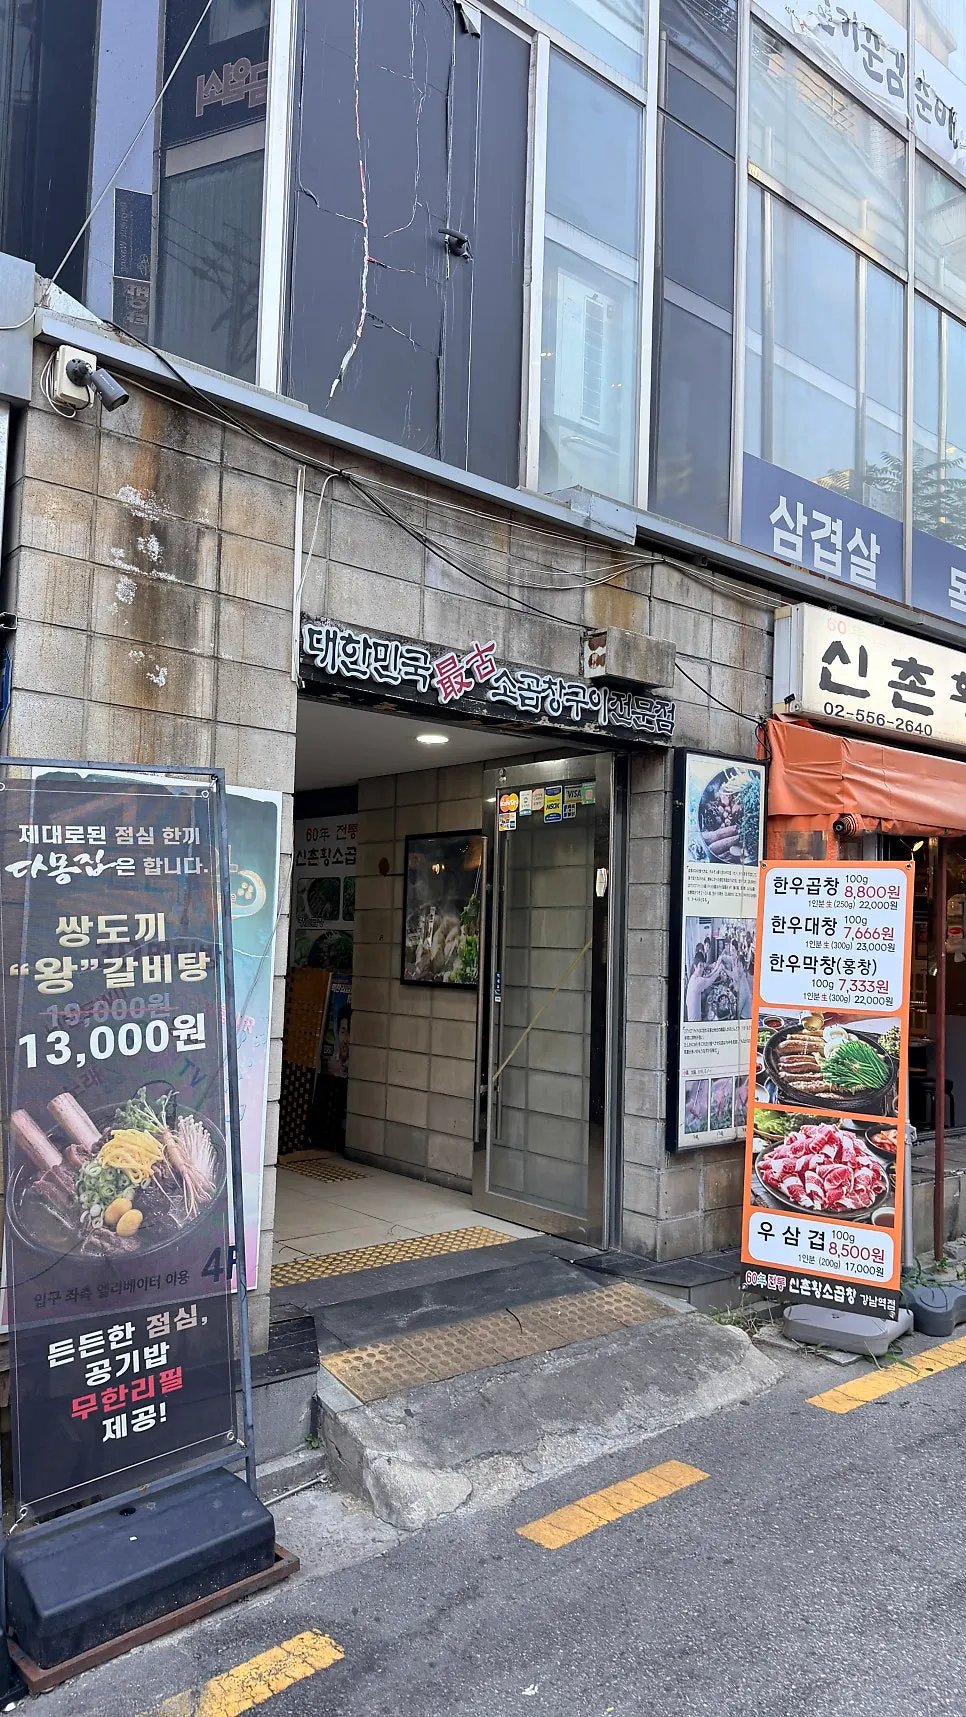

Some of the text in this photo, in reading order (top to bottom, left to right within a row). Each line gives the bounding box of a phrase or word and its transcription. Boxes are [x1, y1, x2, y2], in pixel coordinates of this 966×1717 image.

[769, 495, 881, 591] 삼겹살
[302, 624, 431, 692] 대한민국
[431, 640, 498, 704] 最古
[823, 702, 933, 737] 02-556-2640
[18, 824, 200, 845] 제대로된 점심 한끼
[336, 823, 358, 840] 전통
[143, 857, 209, 876] 합니다.
[773, 876, 840, 896] 한우곱창
[845, 874, 869, 885] 100g
[844, 885, 901, 900] 8,800원
[859, 900, 898, 910] 22,000원
[56, 912, 166, 948] 쌍도끼
[771, 915, 867, 936] 한우대창 100g
[843, 926, 895, 942] 7,666원
[856, 942, 896, 953] 23,000원
[769, 953, 877, 976] 한우막창(홍창)
[812, 978, 890, 995] 100g 7,333원
[46, 992, 171, 1029] 19,000원
[854, 995, 894, 1007] 22,000원
[18, 1012, 206, 1069] 13,000원
[831, 1229, 856, 1244] 100g
[828, 1241, 885, 1265] 8,500원
[798, 1253, 885, 1278] 1인분 (200g) 17,000원
[165, 1269, 190, 1287] 이용
[859, 1293, 897, 1312] 강남역점
[47, 1303, 208, 1369] 든든한 점심,
[84, 1341, 171, 1387] 공기밥
[71, 1366, 184, 1421] 무한리필
[102, 1401, 168, 1443] 제공!
